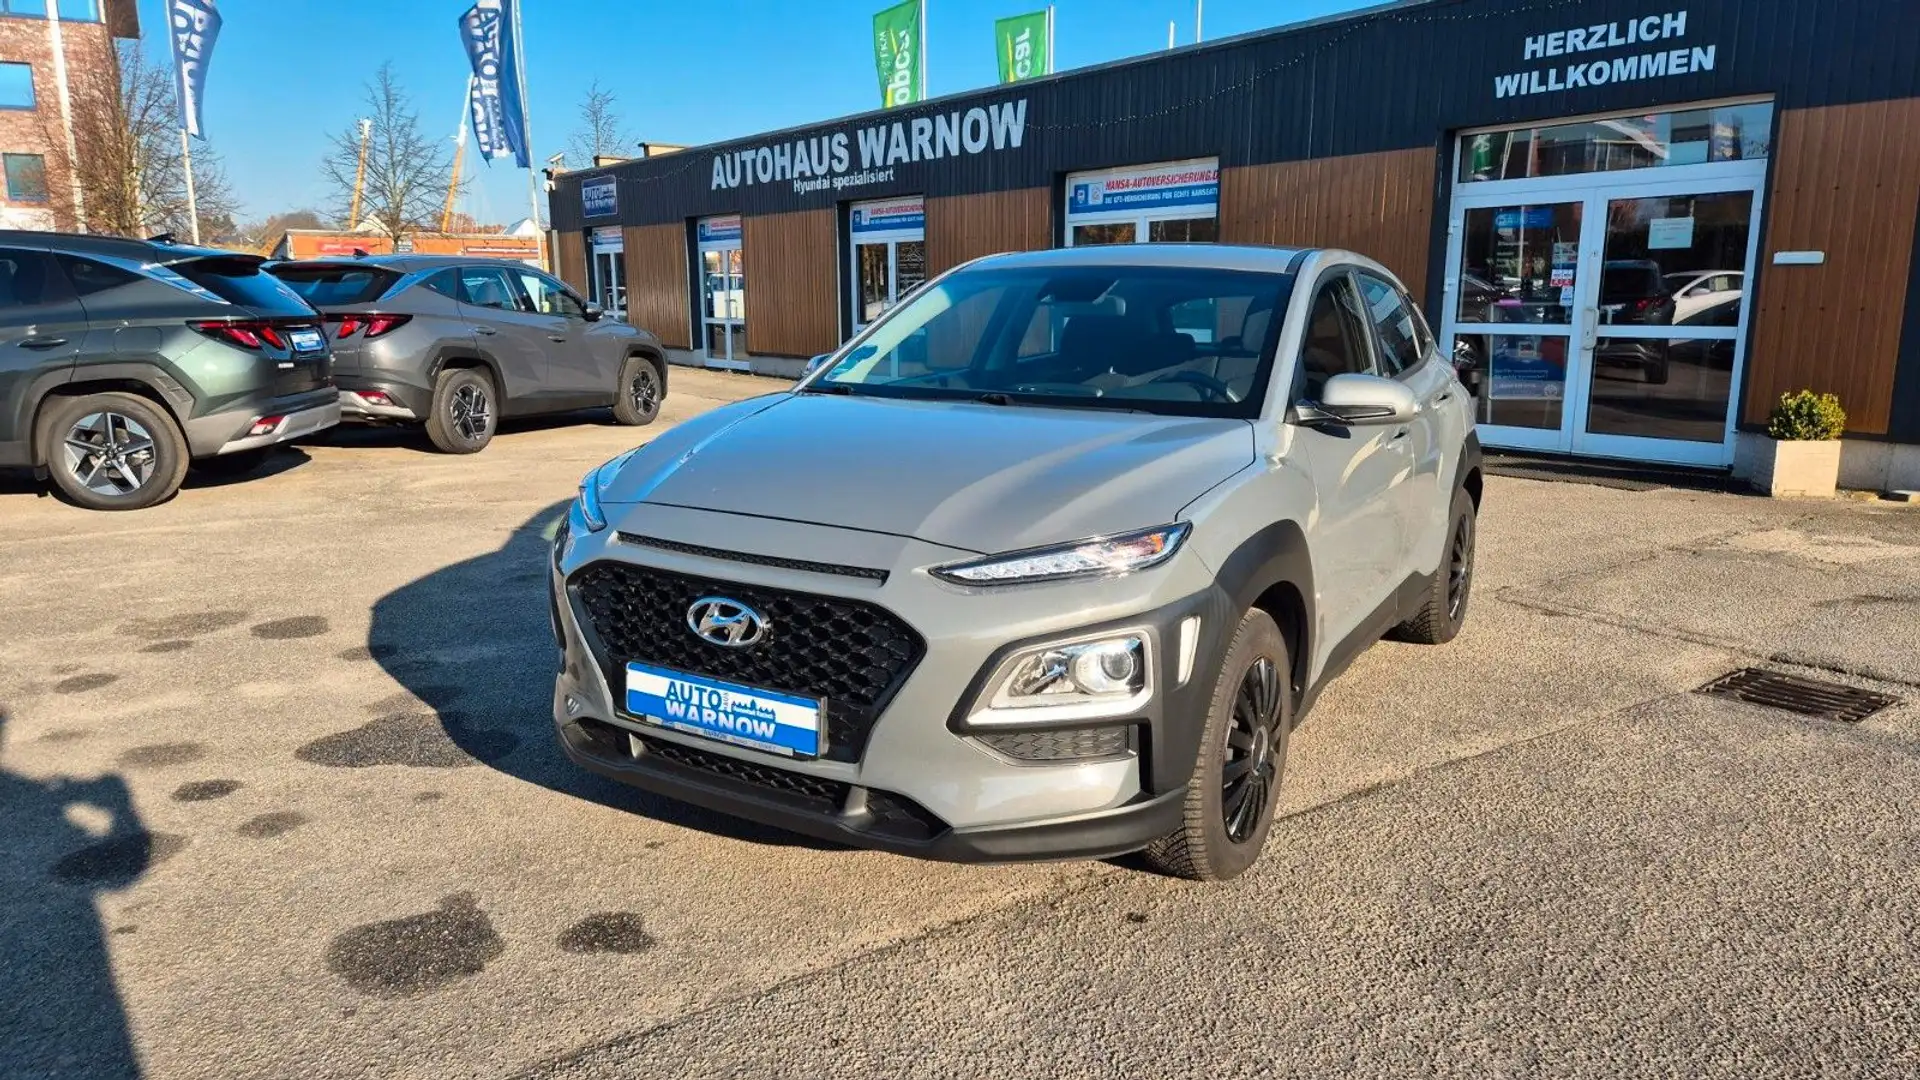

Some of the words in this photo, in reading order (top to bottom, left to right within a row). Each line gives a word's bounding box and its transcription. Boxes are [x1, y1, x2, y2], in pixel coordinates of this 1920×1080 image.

[1524, 11, 1687, 60] HERZLICH
[1495, 44, 1716, 99] WILLKOMMEN
[711, 132, 849, 190] AUTOHAUS
[857, 98, 1027, 169] WARNOW
[793, 177, 830, 195] Hyundai
[832, 168, 895, 191] spezialisiert
[665, 681, 722, 708] AUTO
[665, 700, 776, 739] WARNOW
